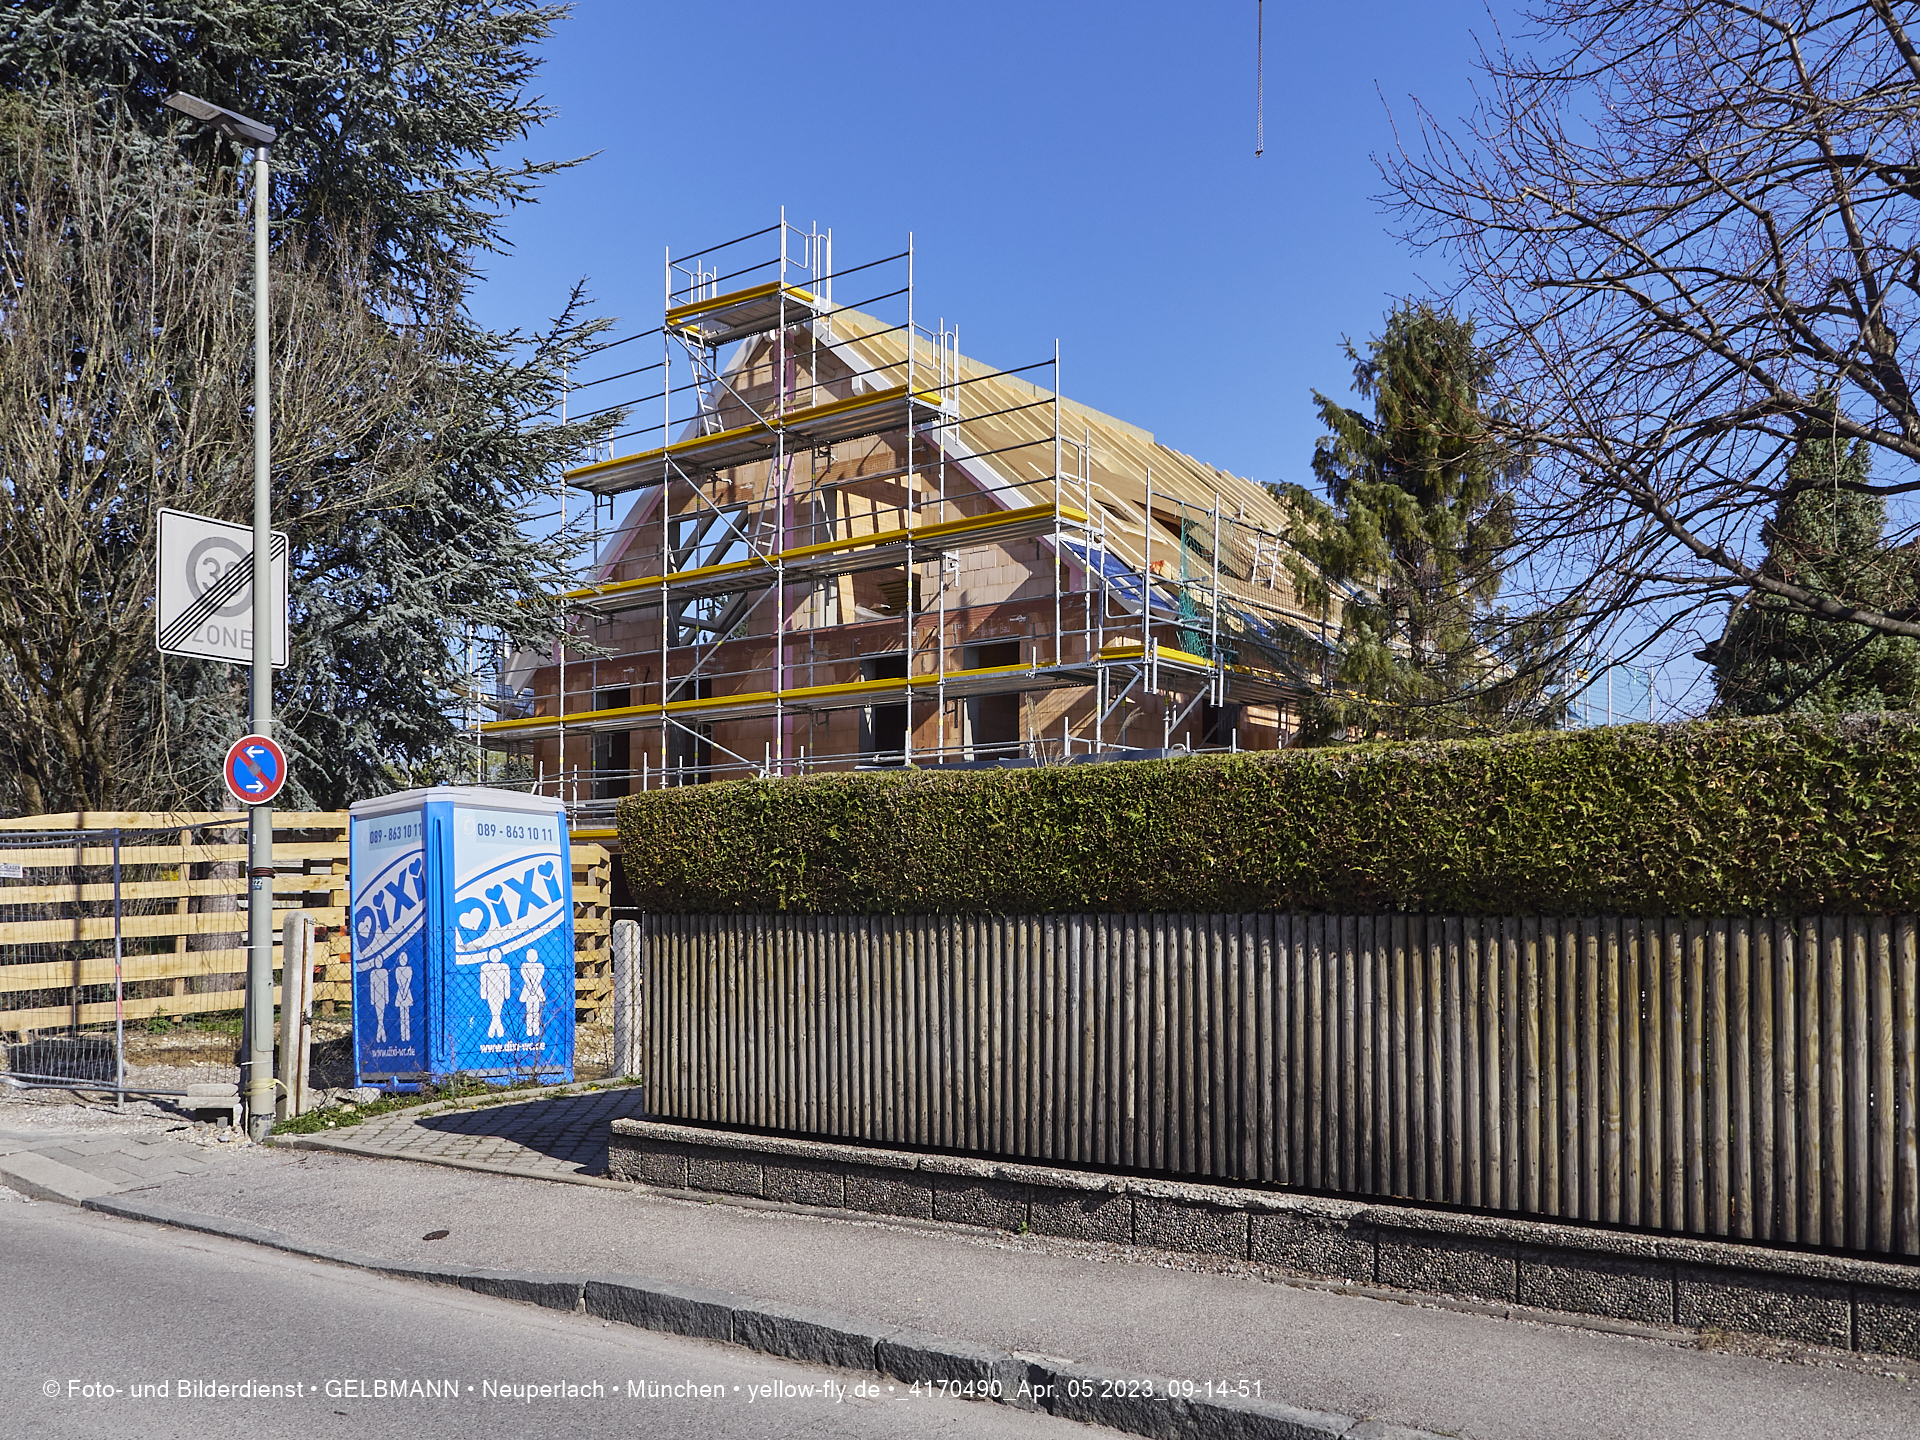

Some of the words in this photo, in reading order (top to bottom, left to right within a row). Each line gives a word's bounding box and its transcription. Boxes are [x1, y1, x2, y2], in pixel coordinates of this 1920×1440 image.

[369, 829, 382, 844] 089
[388, 825, 402, 841] 863
[403, 824, 412, 839] 10
[414, 822, 422, 836] 11
[477, 823, 496, 837] 089
[506, 825, 524, 839] 863
[528, 827, 539, 840] 10
[542, 828, 553, 841] 11
